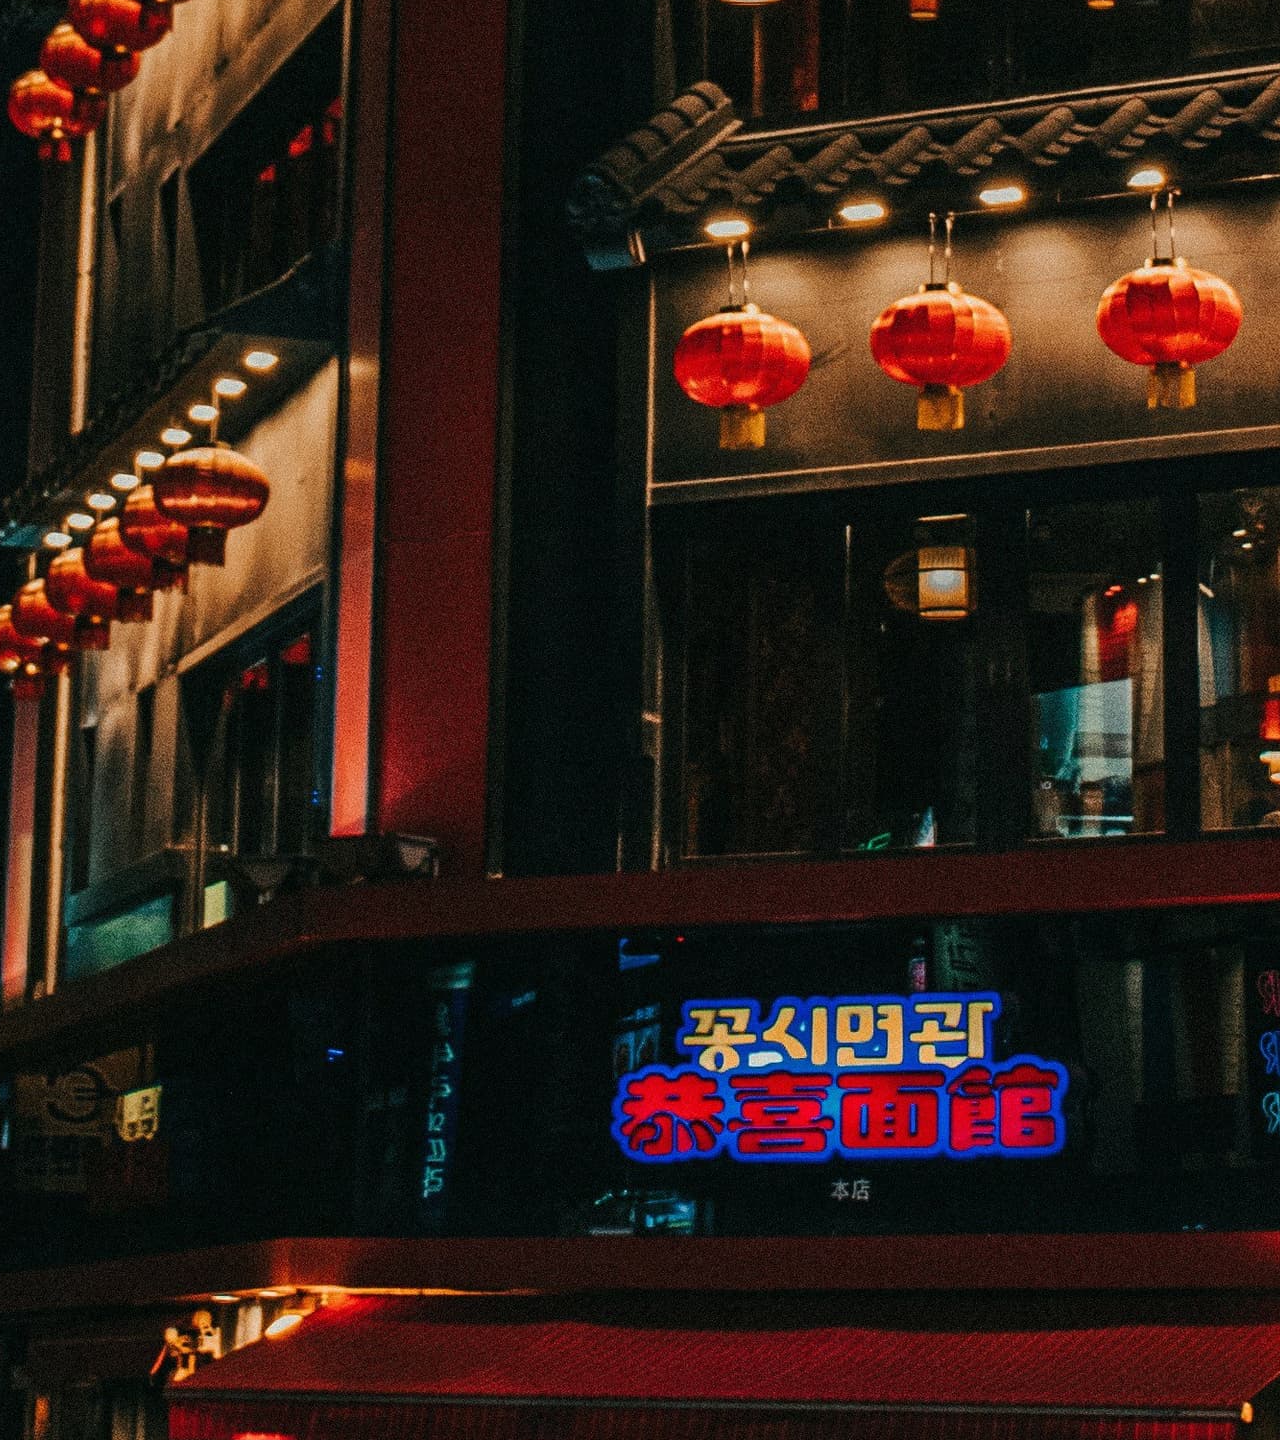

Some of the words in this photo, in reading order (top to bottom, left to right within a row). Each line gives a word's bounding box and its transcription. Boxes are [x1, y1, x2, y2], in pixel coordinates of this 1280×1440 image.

[619, 1062, 1061, 1157] 恭喜面館
[829, 1177, 873, 1203] 本店
